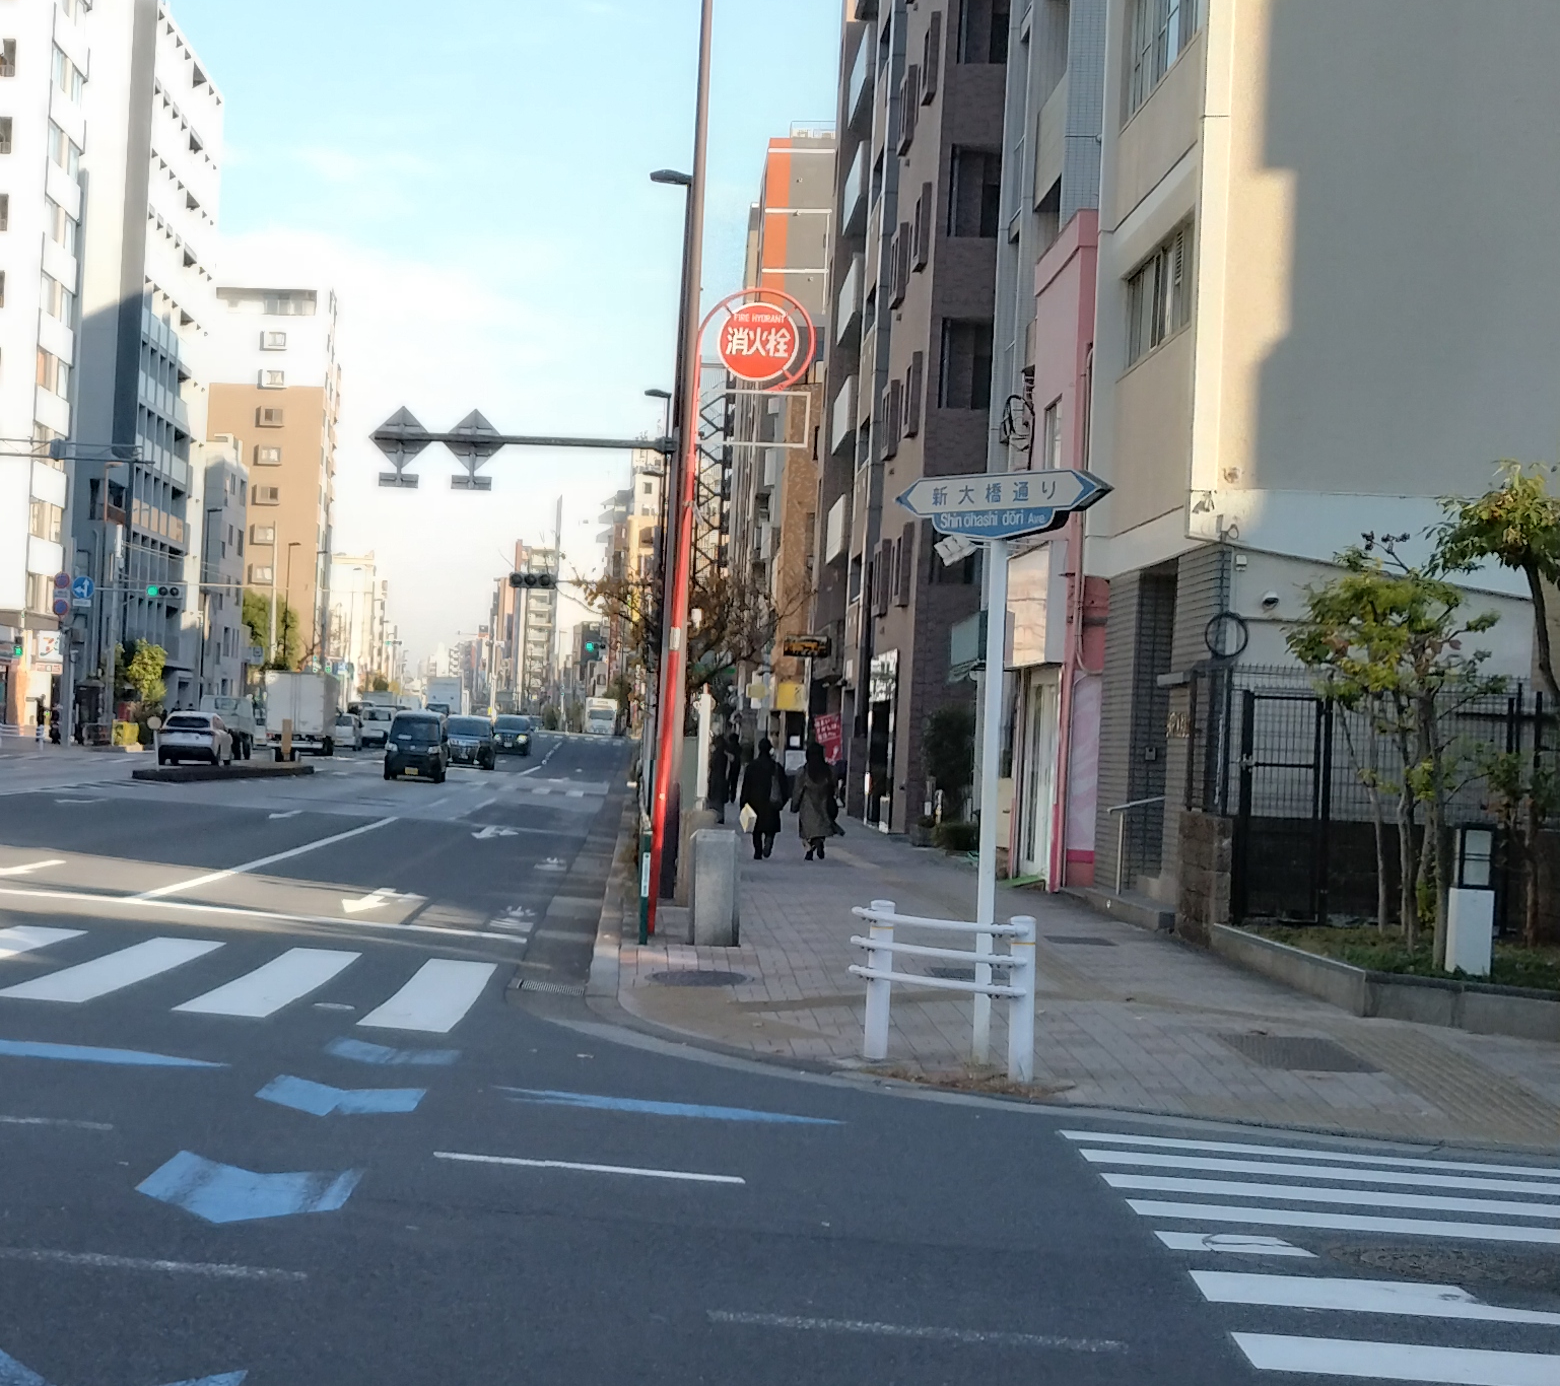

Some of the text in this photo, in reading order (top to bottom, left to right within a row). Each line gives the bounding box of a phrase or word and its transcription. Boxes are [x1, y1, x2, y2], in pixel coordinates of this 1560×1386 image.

[733, 313, 786, 323] FIRE HYDRANT
[725, 326, 791, 357] 消火栓
[932, 481, 1056, 506] 新大橋通り
[940, 512, 962, 528] Shin
